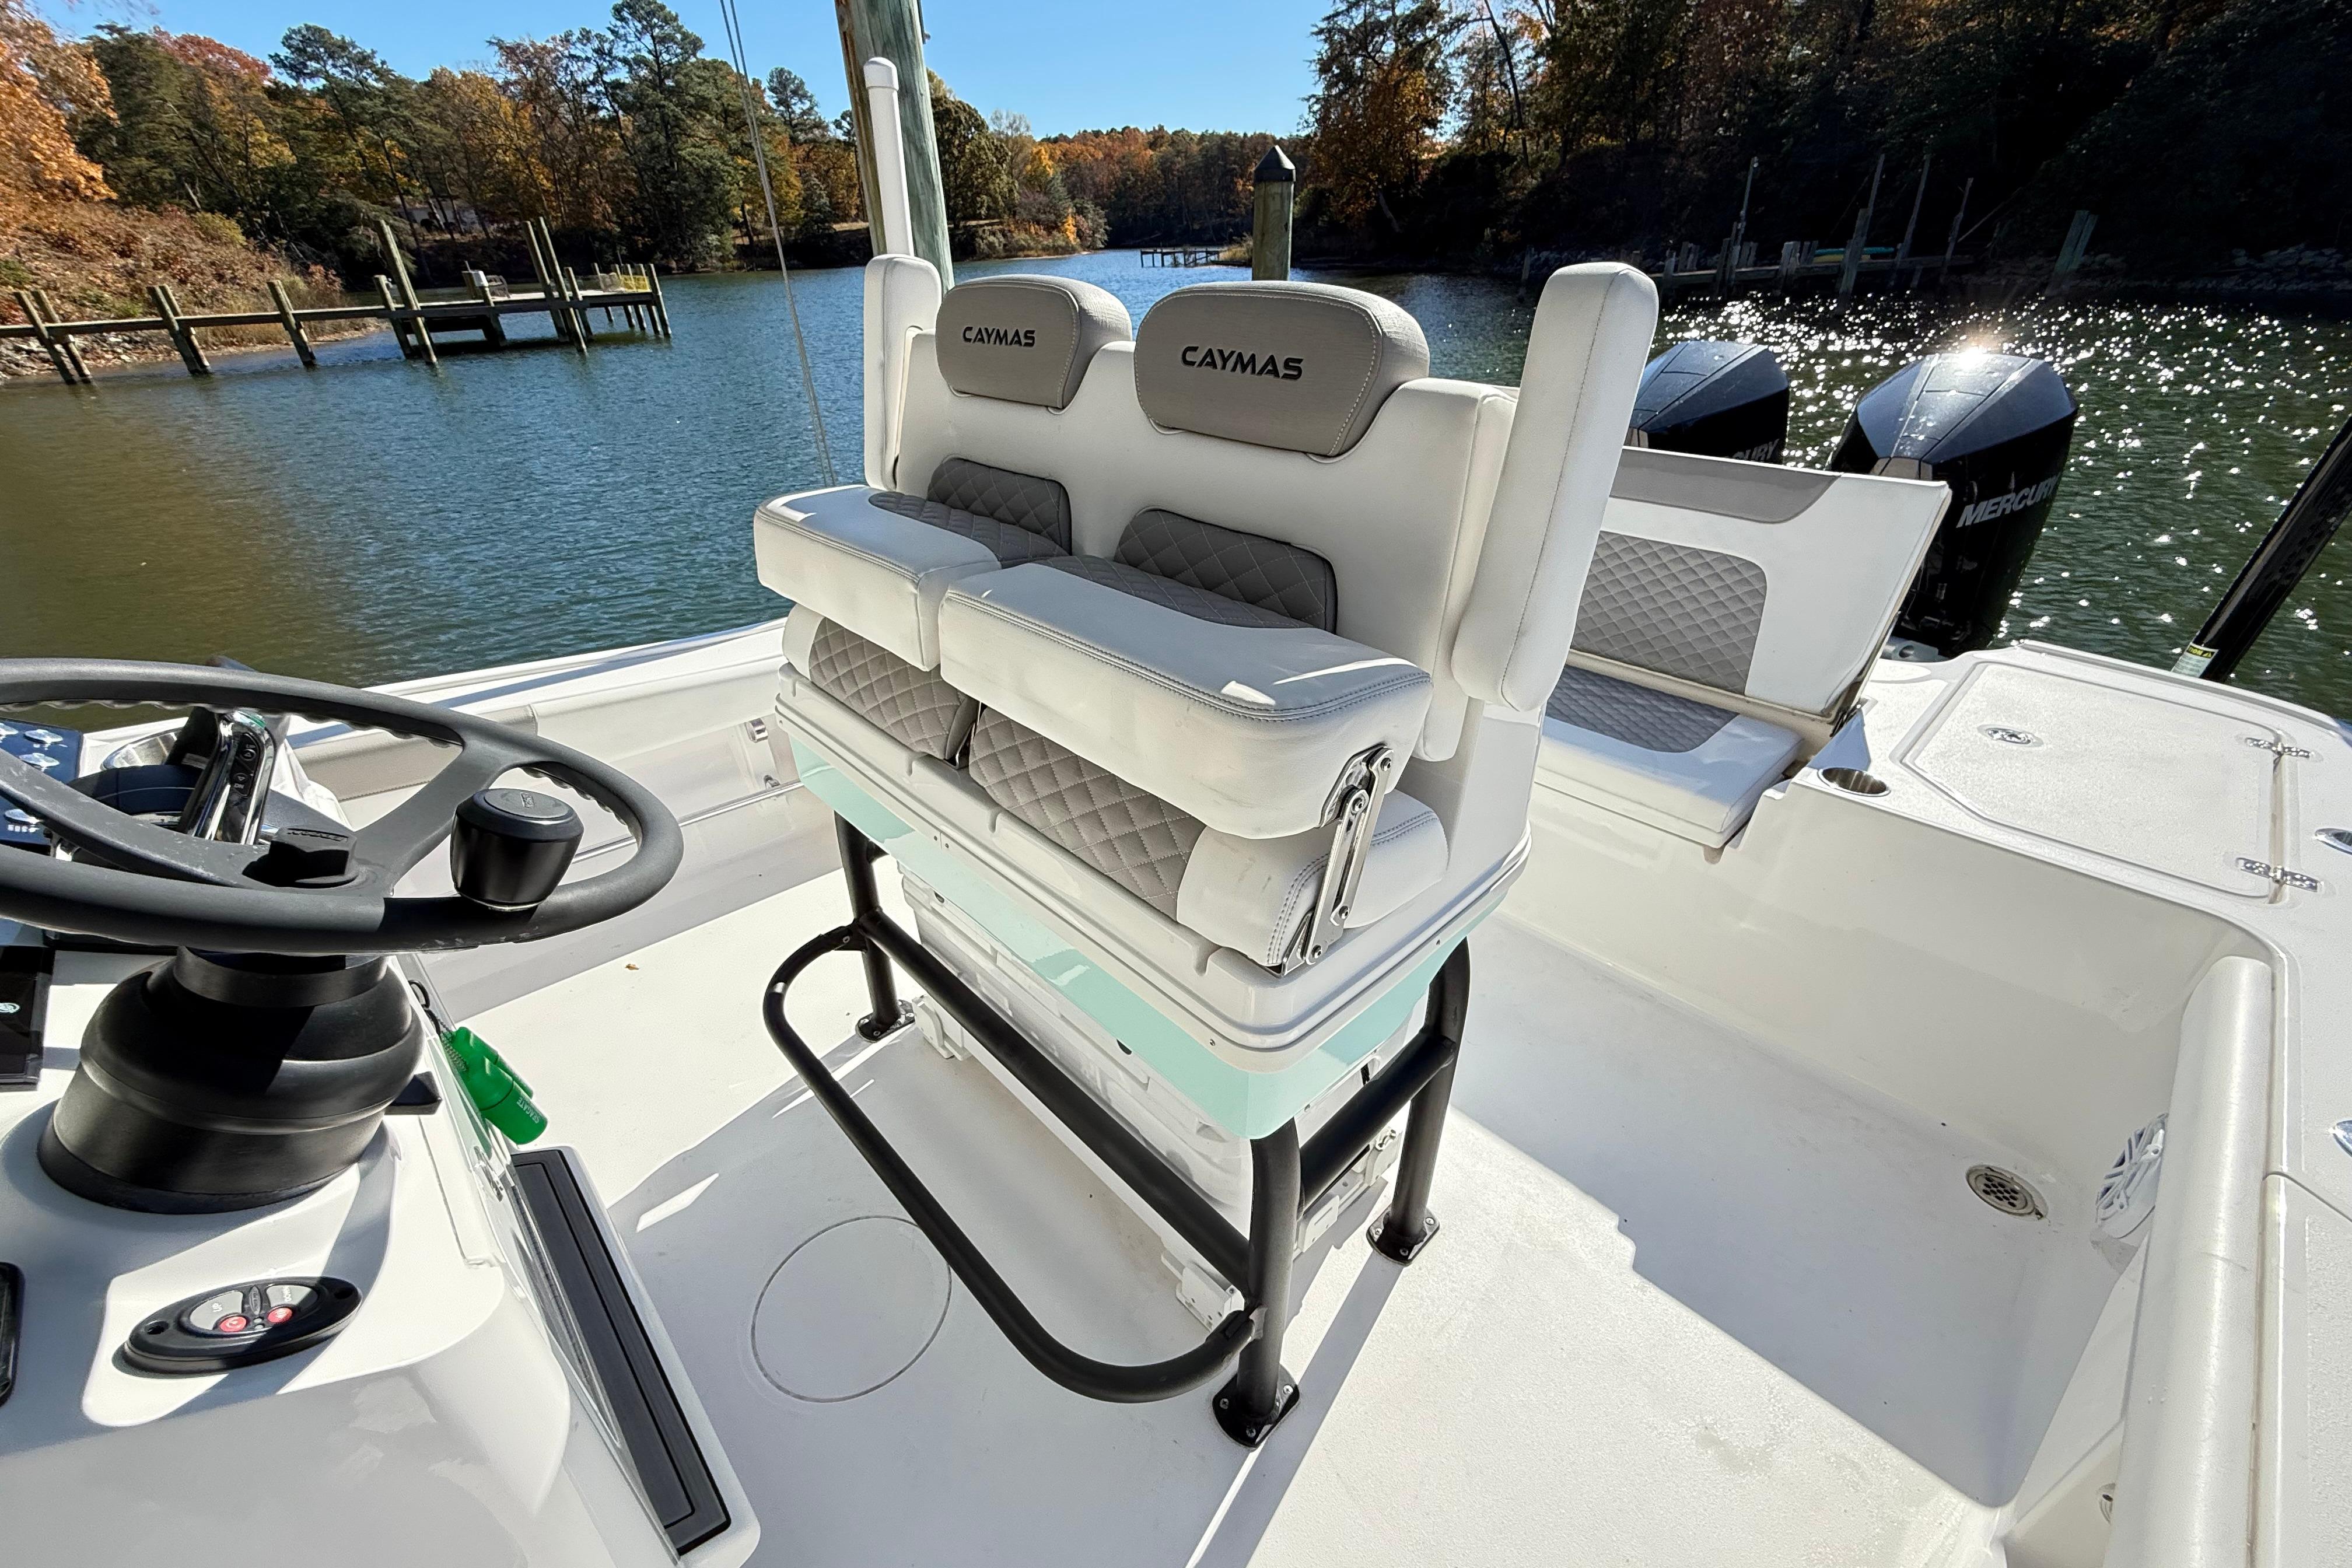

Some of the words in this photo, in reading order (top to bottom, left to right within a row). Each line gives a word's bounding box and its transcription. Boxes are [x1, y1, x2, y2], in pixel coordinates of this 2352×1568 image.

[963, 326, 1036, 348] CAYMAS
[1181, 346, 1304, 380] CAYMAS
[1731, 438, 1779, 461] CURY
[1955, 472, 2062, 528] MERCURY
[212, 1302, 223, 1312] UP
